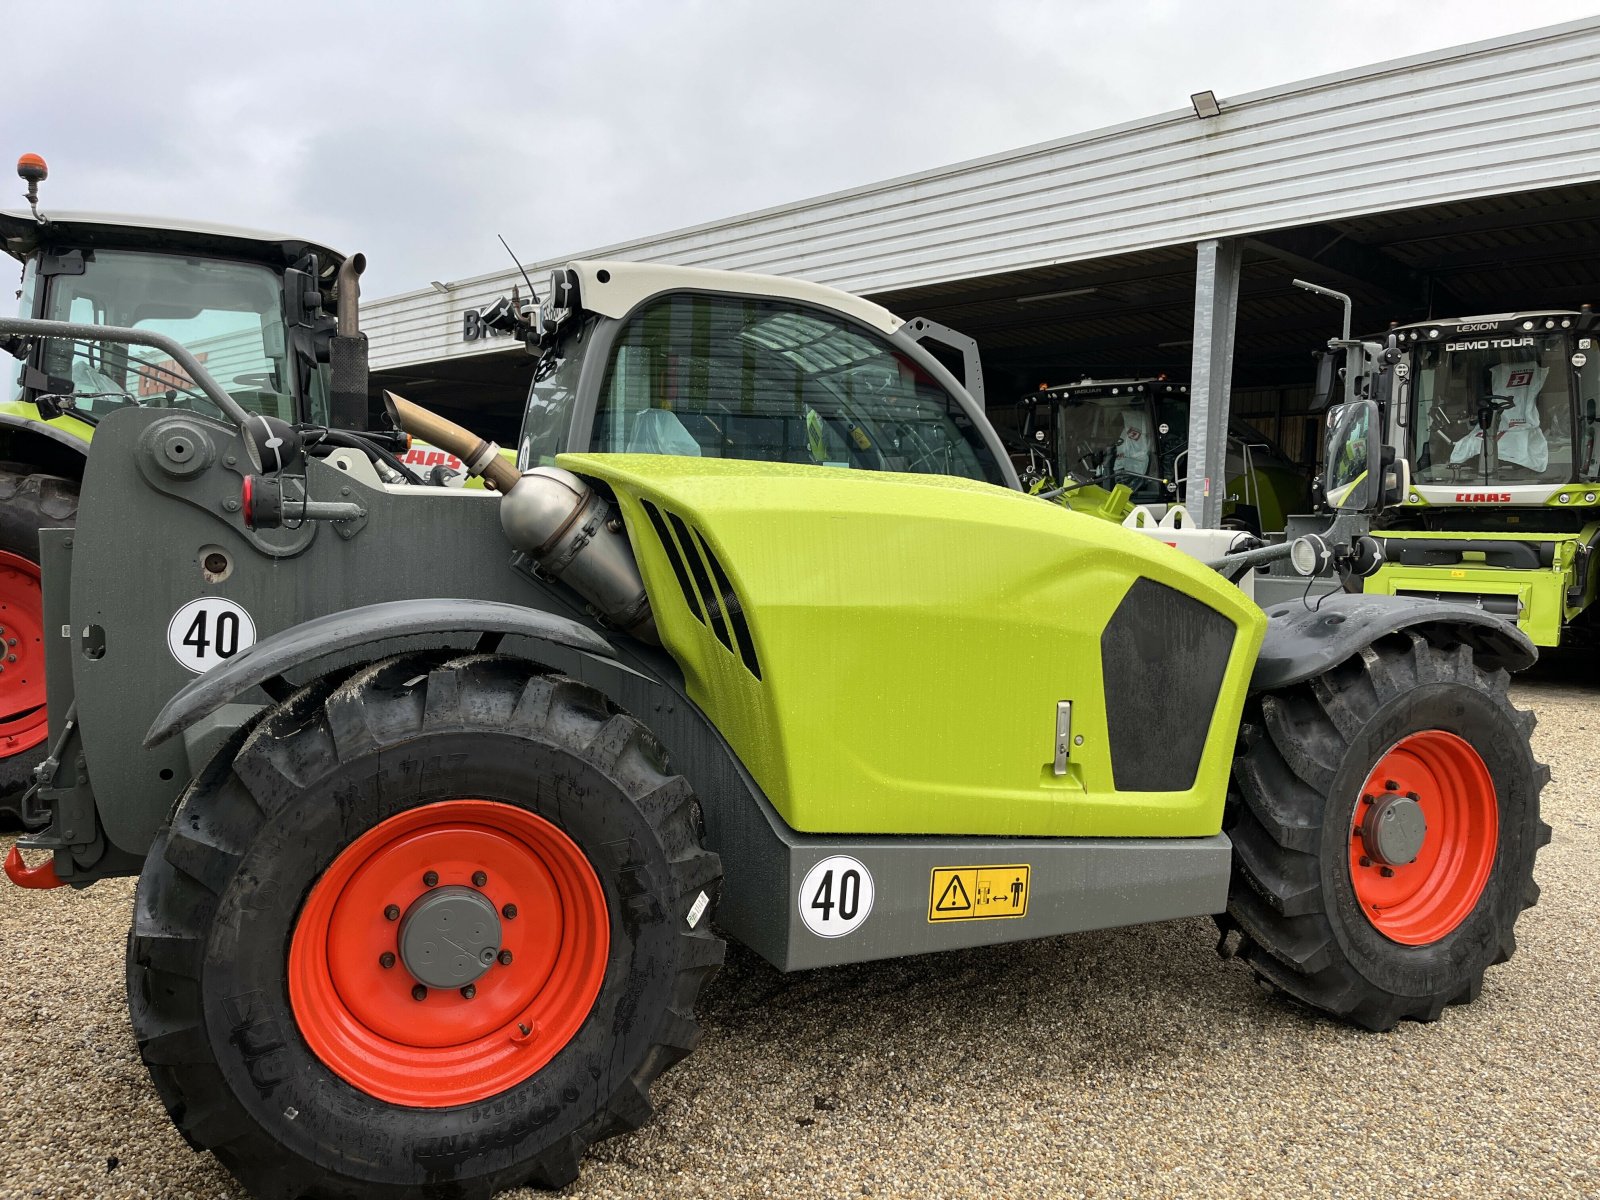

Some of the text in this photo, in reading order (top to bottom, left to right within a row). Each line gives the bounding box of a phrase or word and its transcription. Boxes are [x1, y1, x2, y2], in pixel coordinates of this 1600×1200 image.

[1456, 322, 1499, 333] LEXION
[1445, 337, 1534, 352] DEMO TOUR
[1455, 493, 1512, 503] CLAAS
[182, 610, 240, 659] 40
[811, 869, 861, 921] 40
